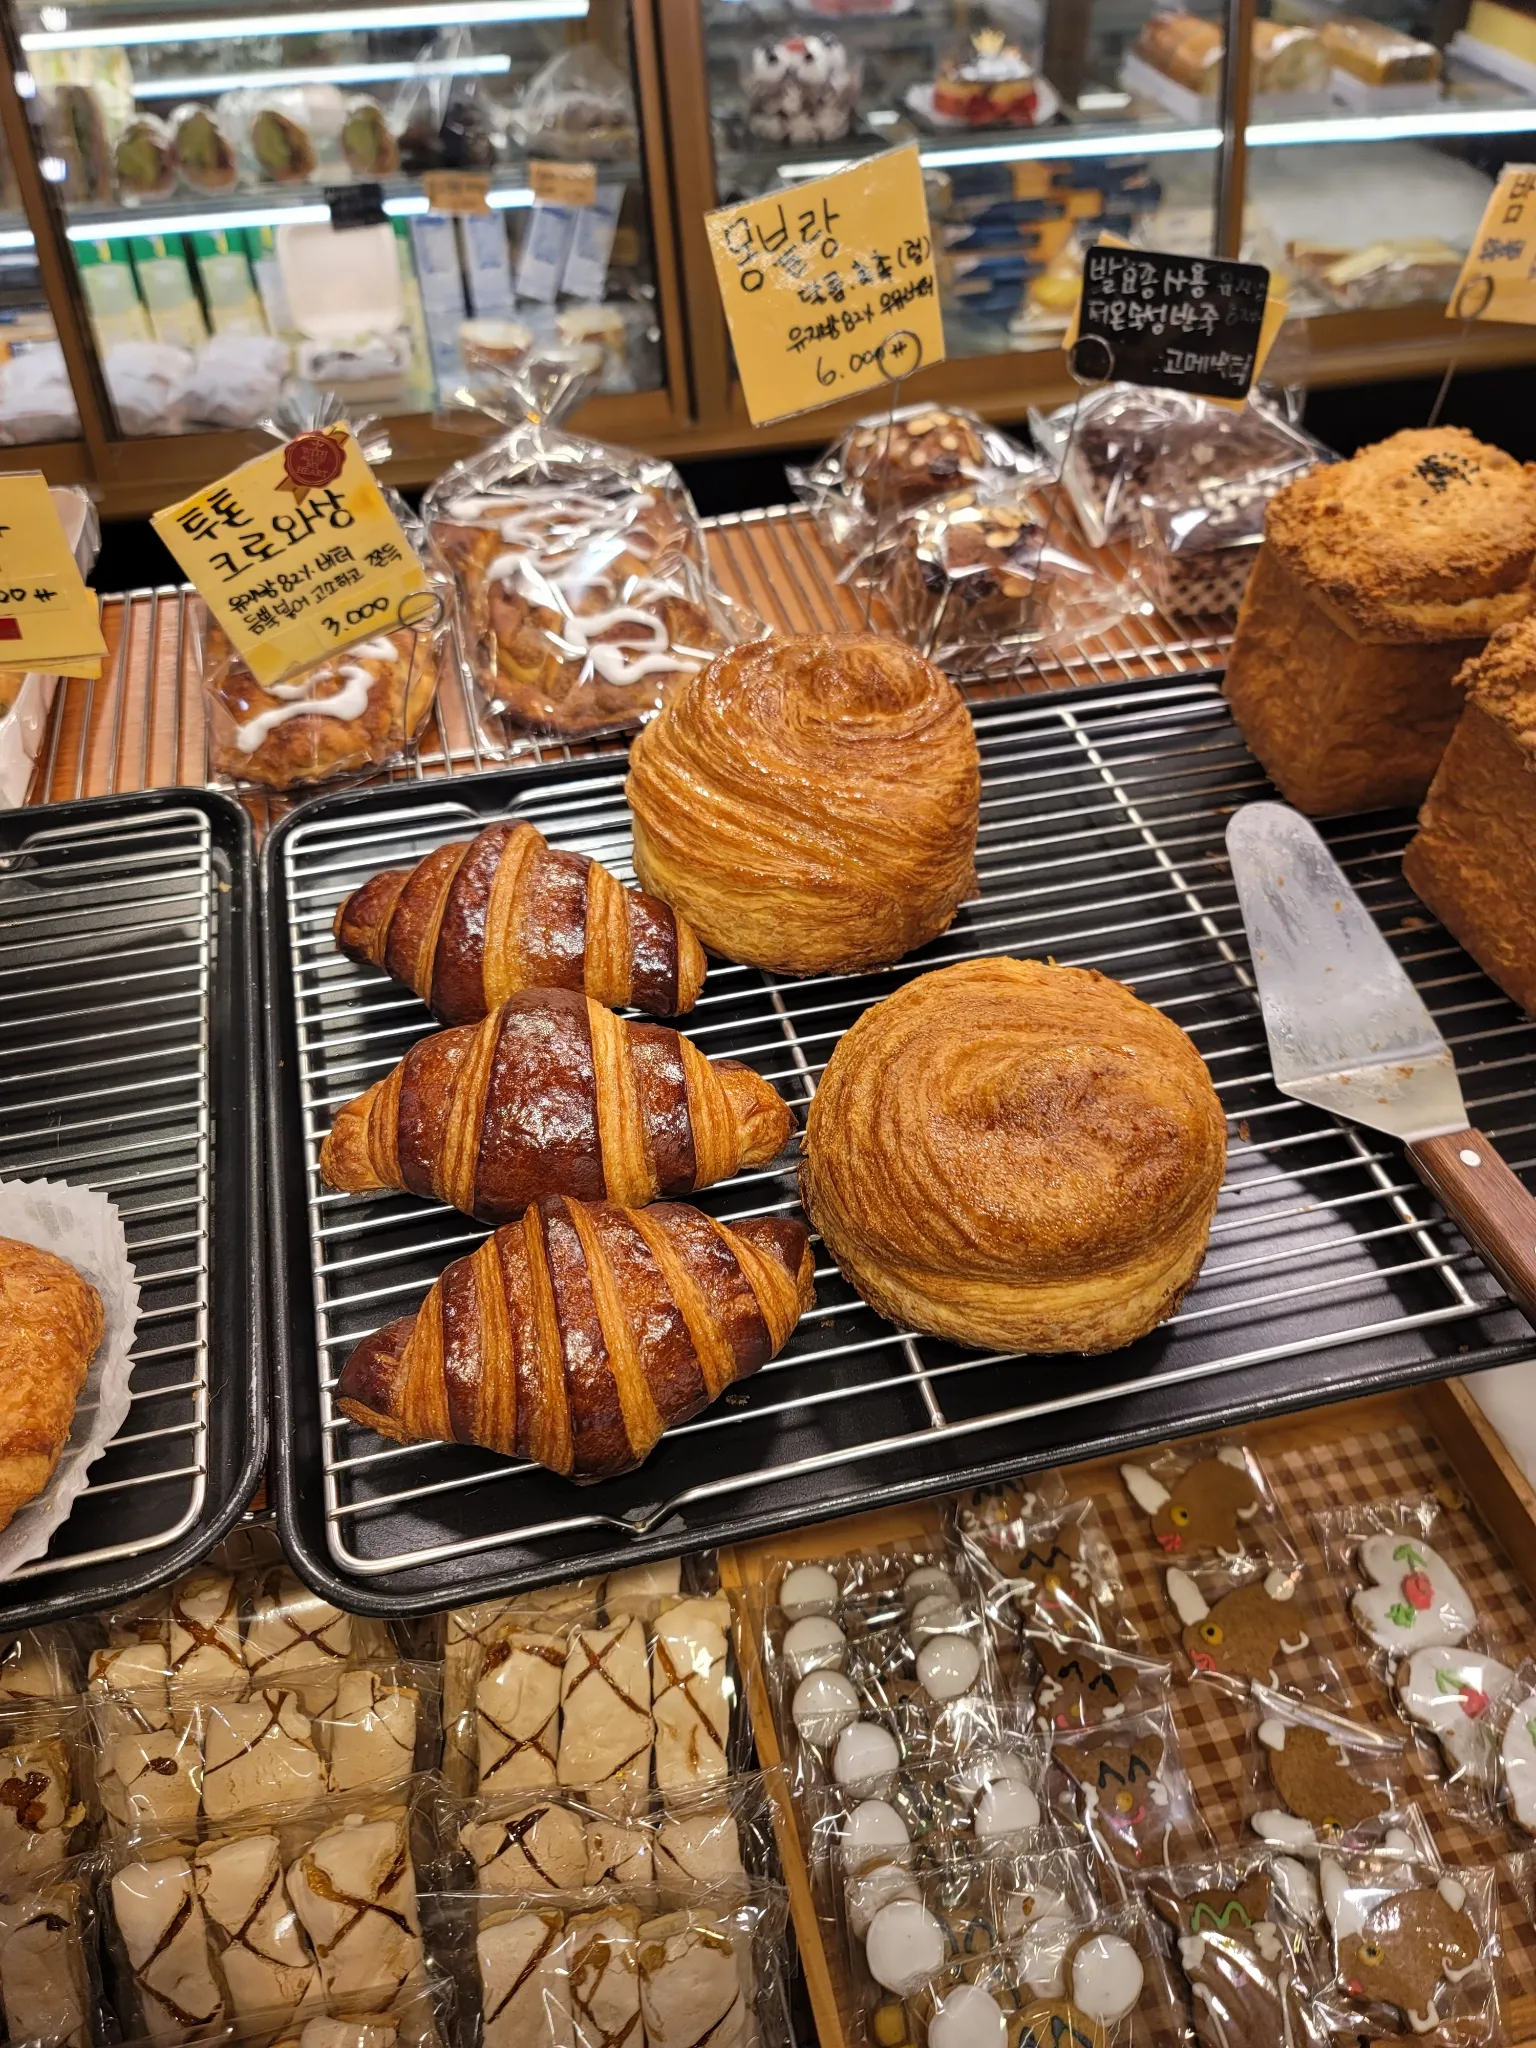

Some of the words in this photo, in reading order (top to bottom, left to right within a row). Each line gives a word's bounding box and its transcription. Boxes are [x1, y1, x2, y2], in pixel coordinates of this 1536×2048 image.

[724, 197, 840, 292] 몽블랑
[176, 487, 255, 542] 투톤
[208, 489, 356, 583] 크로와상
[310, 566, 365, 605] 고소하고
[363, 542, 403, 571] 쫀득
[314, 545, 356, 573] 버터
[320, 596, 390, 638] 3.000
